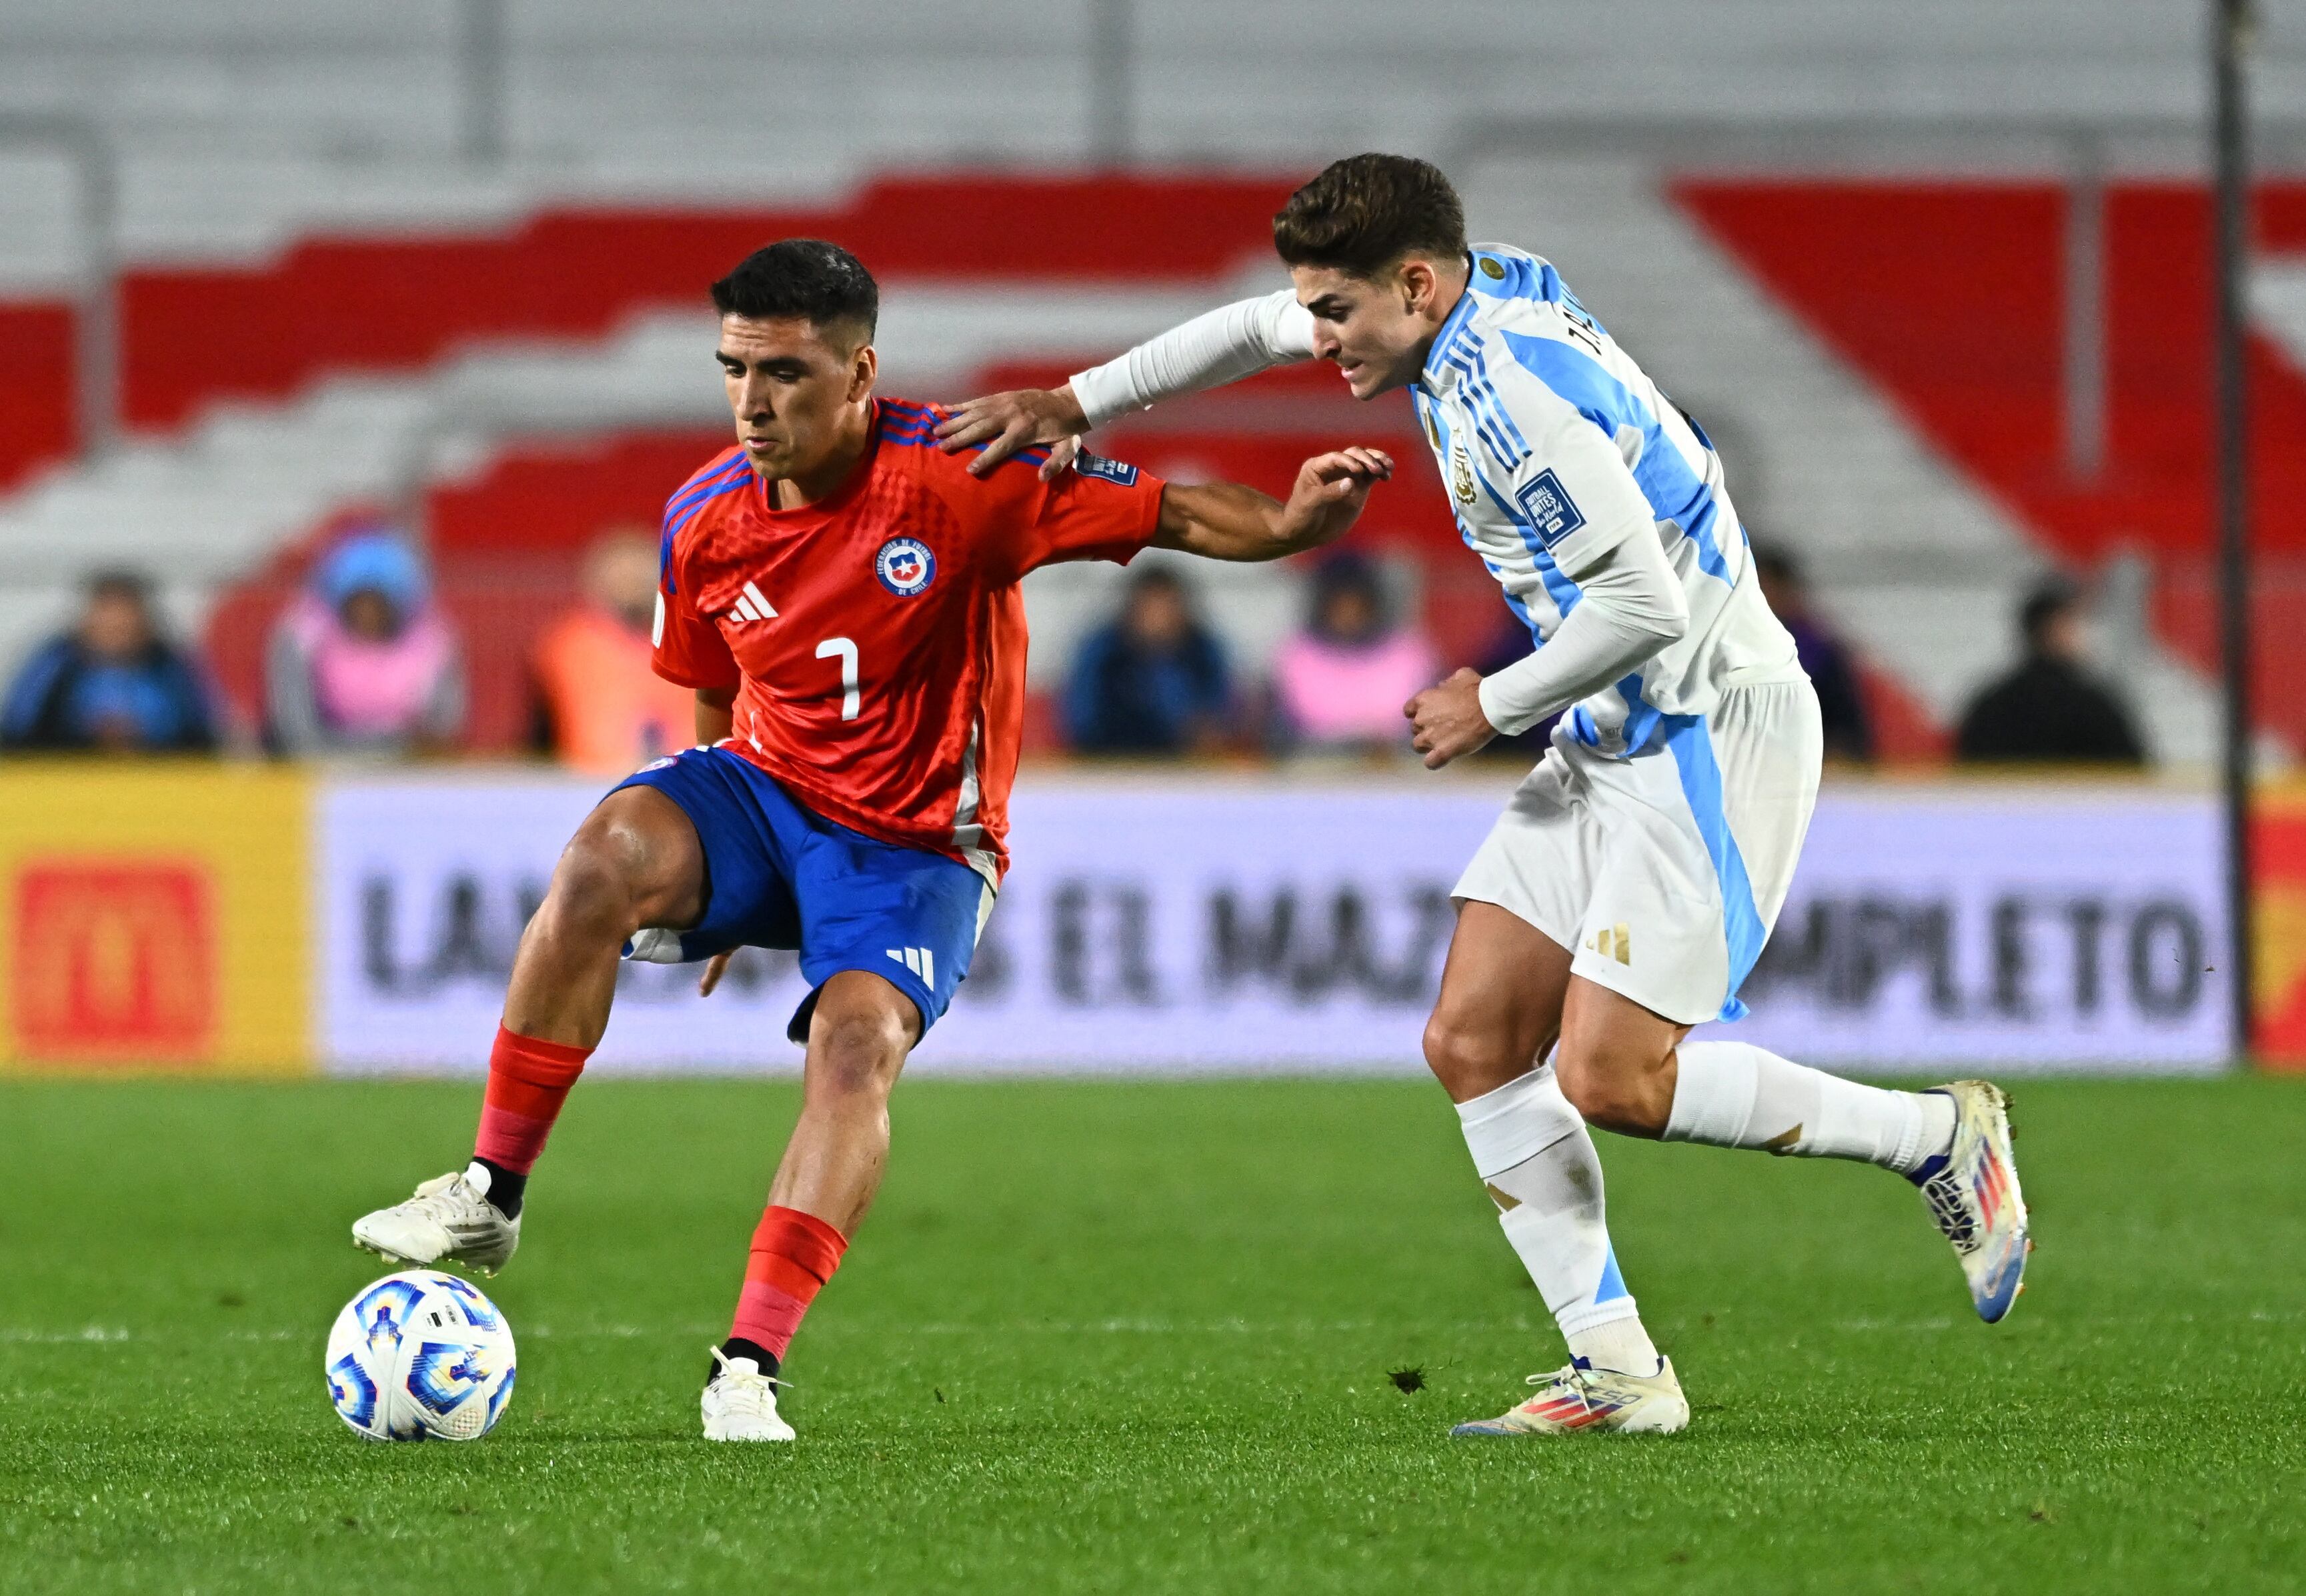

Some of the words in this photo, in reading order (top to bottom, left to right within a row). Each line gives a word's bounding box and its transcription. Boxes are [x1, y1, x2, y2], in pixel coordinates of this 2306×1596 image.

[1529, 493, 1556, 517] UNITES
[1548, 521, 1560, 531] FIFA
[816, 637, 860, 721] 7
[1206, 883, 1455, 1005] MAZ
